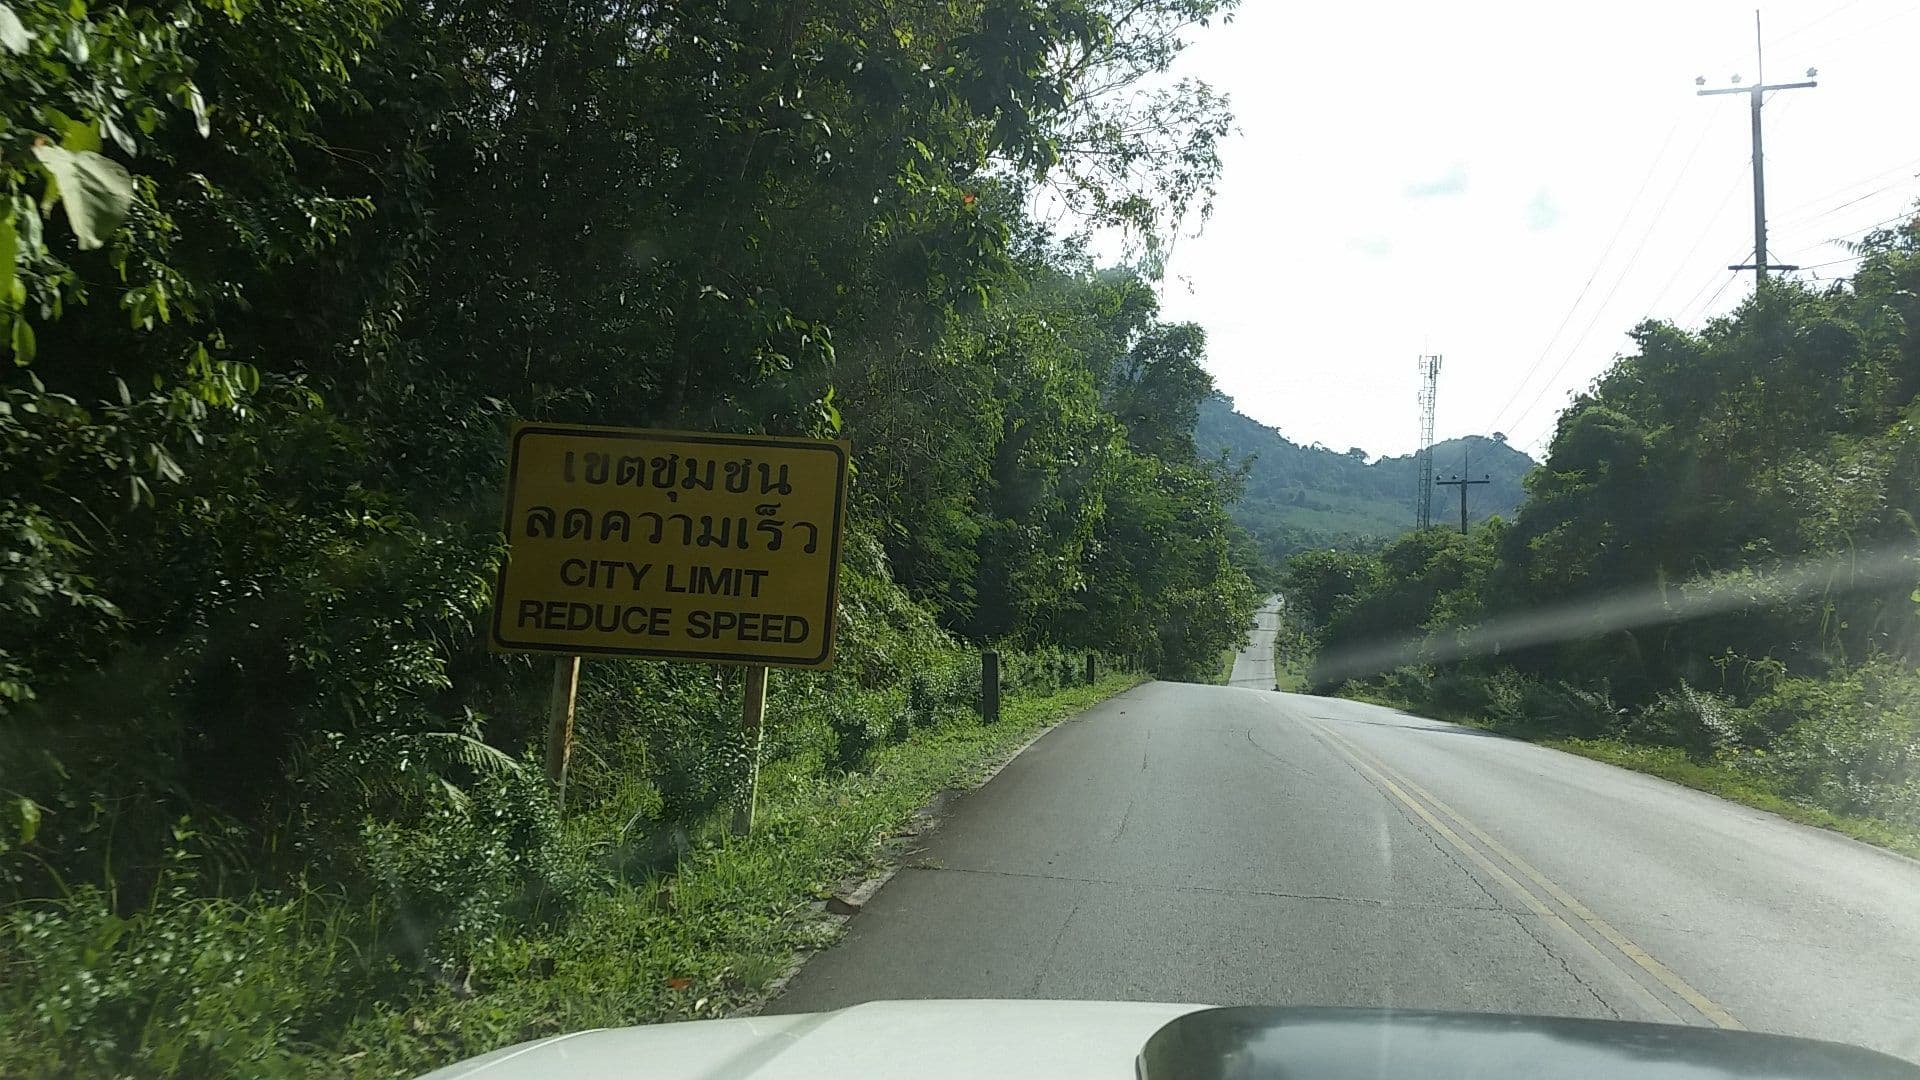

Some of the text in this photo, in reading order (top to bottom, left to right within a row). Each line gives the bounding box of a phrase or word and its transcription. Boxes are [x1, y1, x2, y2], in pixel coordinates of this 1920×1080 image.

[563, 450, 793, 502] เขตชุมชน
[525, 502, 819, 554] ลดความเร็ว
[559, 558, 769, 598] CITY LIMIT
[516, 599, 810, 644] REDUCE SPEED
